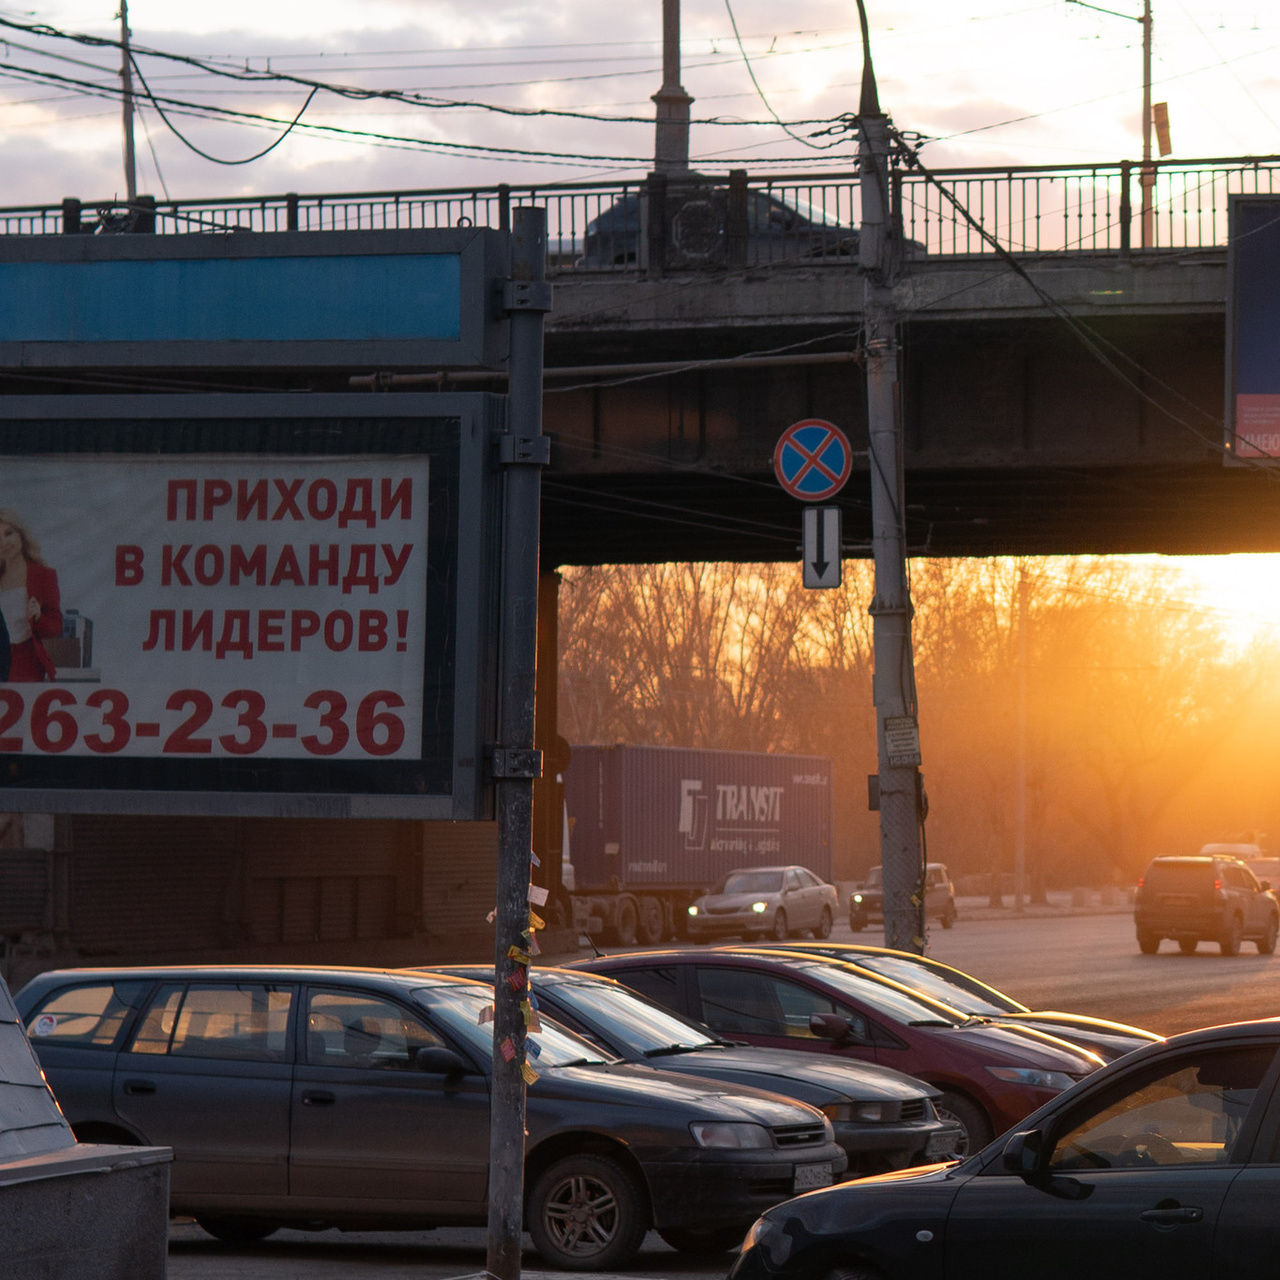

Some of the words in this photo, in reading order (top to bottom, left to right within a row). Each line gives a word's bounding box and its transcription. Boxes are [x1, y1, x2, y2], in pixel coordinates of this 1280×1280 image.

[166, 478, 412, 529] ПРИХОДИ
[115, 545, 144, 587] В
[161, 543, 414, 594] КОМАНДУ
[142, 609, 409, 659] ЛИДЕРОВ!
[716, 784, 784, 821] TRANSIT
